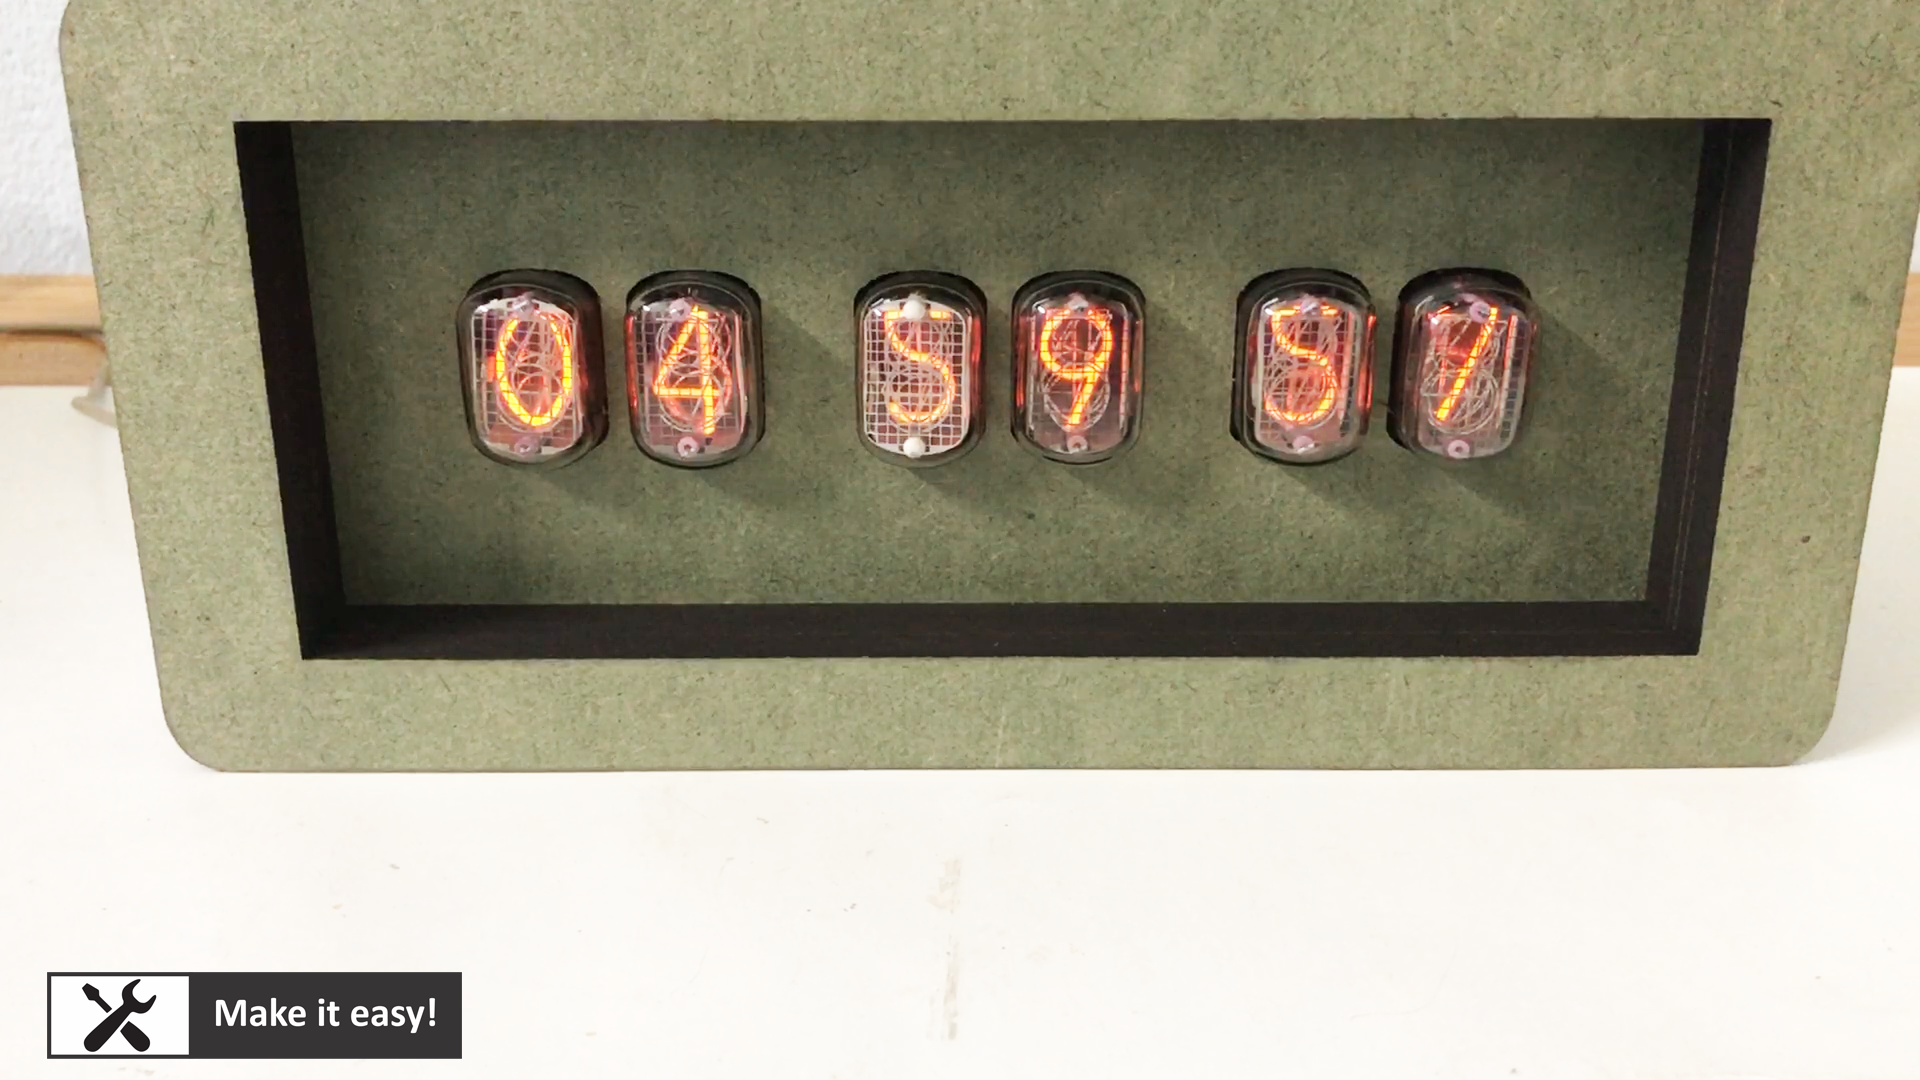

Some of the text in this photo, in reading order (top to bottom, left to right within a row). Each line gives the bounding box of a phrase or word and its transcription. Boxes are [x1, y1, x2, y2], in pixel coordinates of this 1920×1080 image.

[494, 304, 1498, 436] 04 59 57
